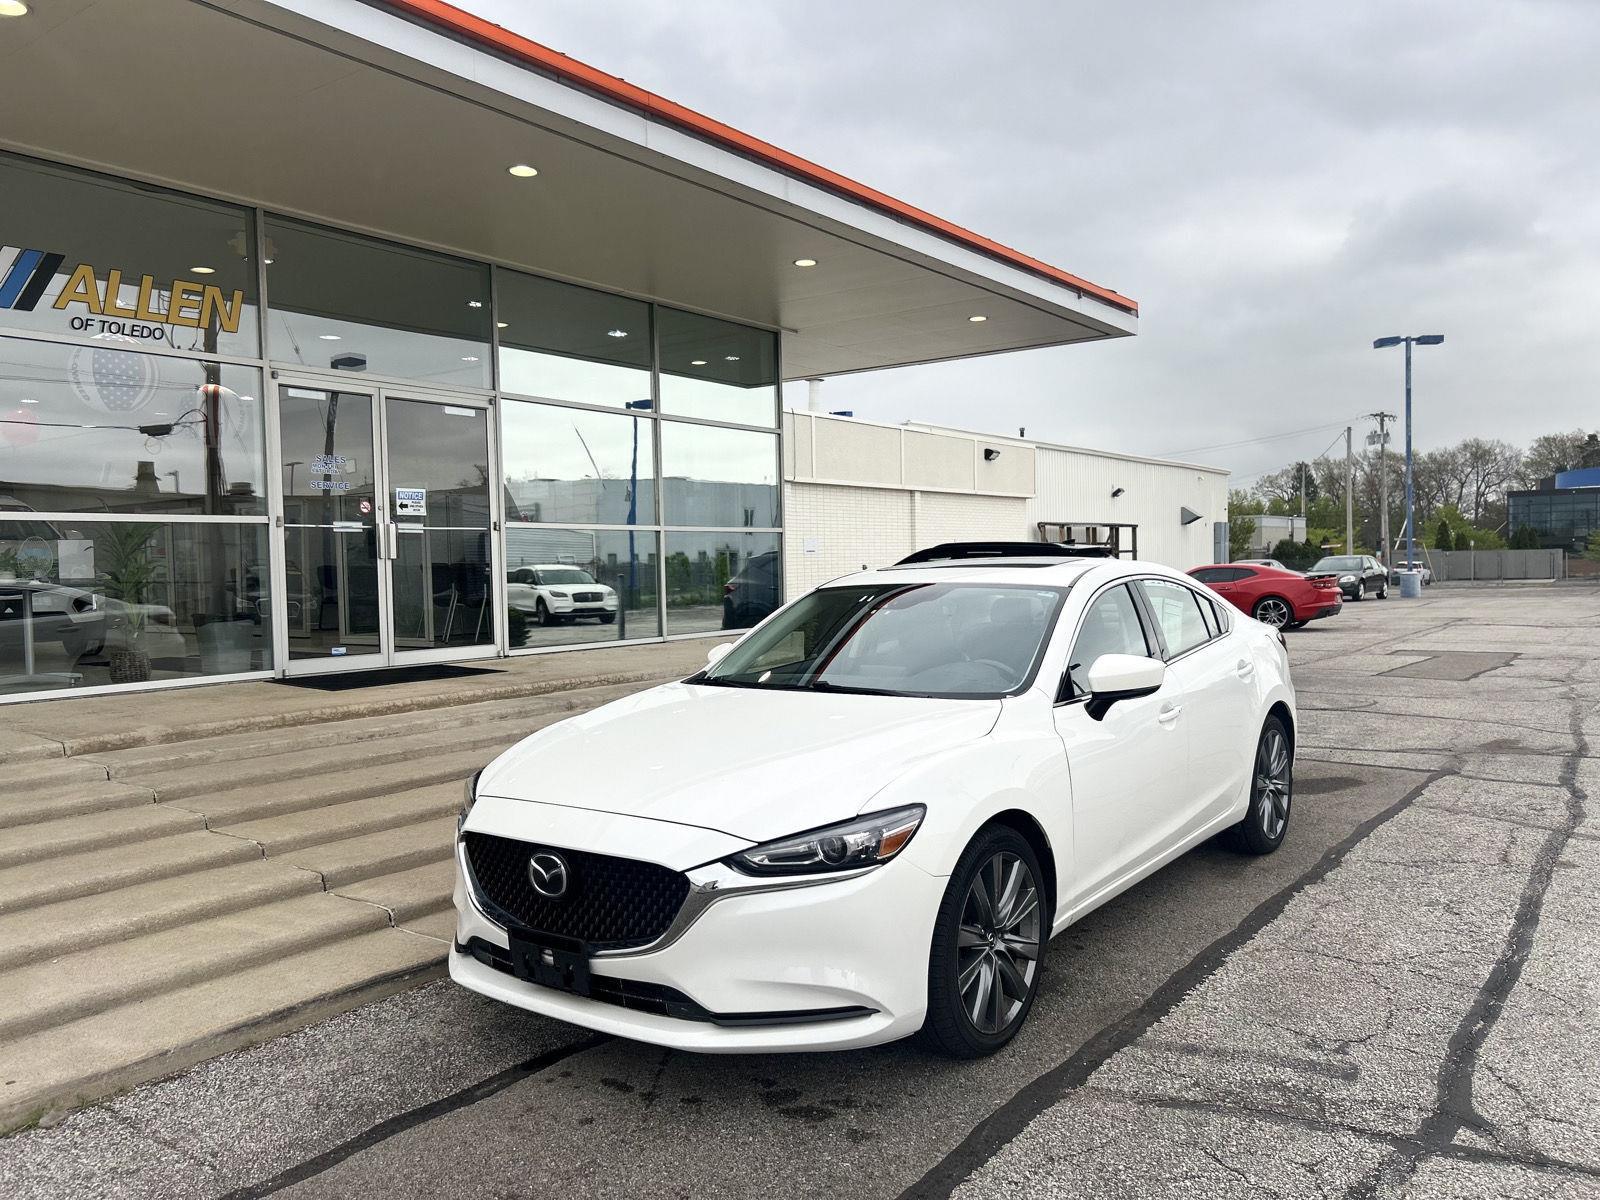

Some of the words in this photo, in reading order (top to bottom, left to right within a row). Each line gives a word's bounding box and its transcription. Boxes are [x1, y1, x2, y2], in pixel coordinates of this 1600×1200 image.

[53, 263, 243, 333] ALLEN
[70, 316, 95, 331] OF
[99, 319, 164, 340] TOLEDO
[316, 455, 346, 464] SALES
[311, 481, 350, 490] SERVICE
